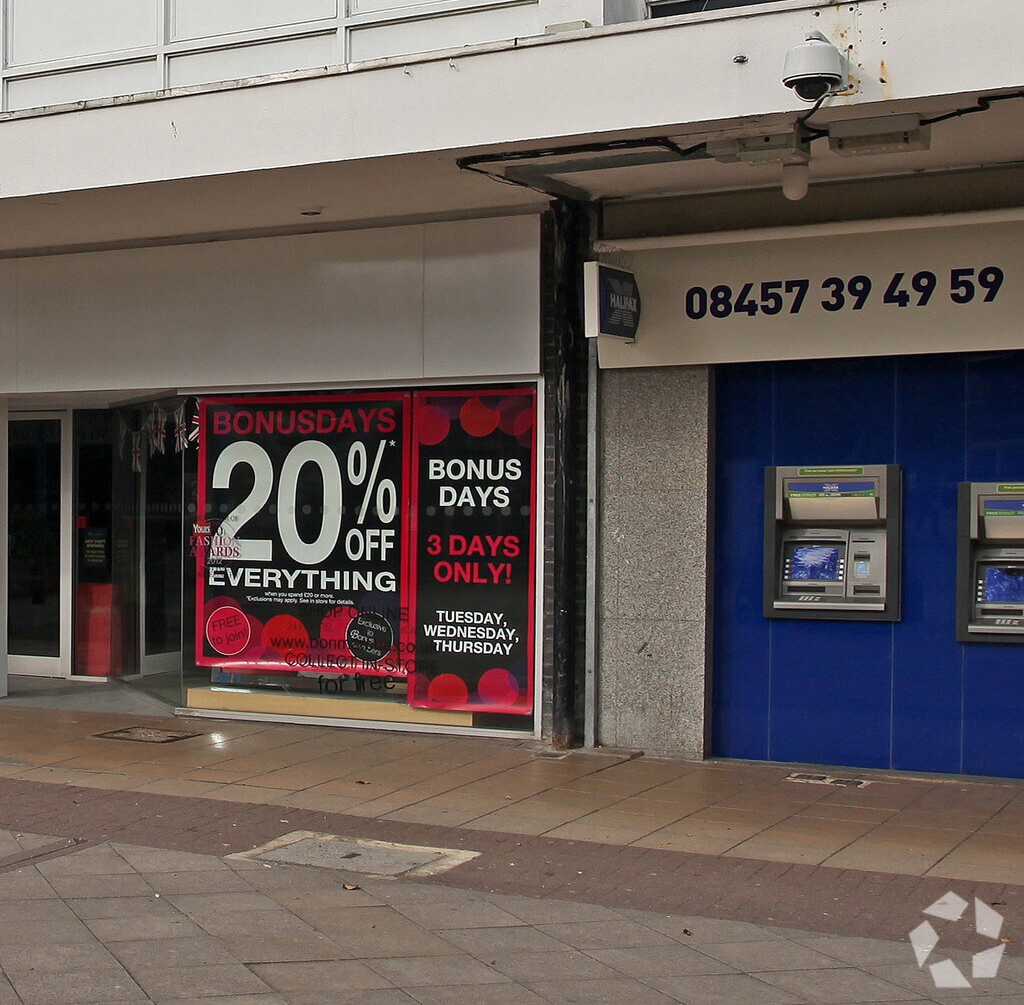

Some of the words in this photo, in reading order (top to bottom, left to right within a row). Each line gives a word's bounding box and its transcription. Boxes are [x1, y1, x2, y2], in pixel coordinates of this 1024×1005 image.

[610, 293, 637, 312] HALIFAX
[684, 279, 810, 320] 08457
[820, 275, 872, 312] 39
[883, 270, 937, 308] 49
[949, 266, 1005, 305] 59
[212, 408, 397, 435] BONUSDAYS
[428, 458, 522, 481] BONUS
[438, 486, 510, 508] DAYS
[190, 546, 240, 557] AARDS
[345, 528, 395, 562] OFF
[426, 535, 442, 556] 3
[449, 535, 521, 558] DAYS
[208, 566, 397, 592] EVERYTHING
[433, 561, 512, 585] ONLY!
[212, 614, 242, 631] FREE
[435, 609, 508, 627] TUESDAY,
[212, 636, 224, 647] to
[423, 624, 520, 643] WEDNESDAY,
[433, 639, 514, 656] THURSDAY
[318, 674, 349, 694] for
[355, 672, 396, 692] free
